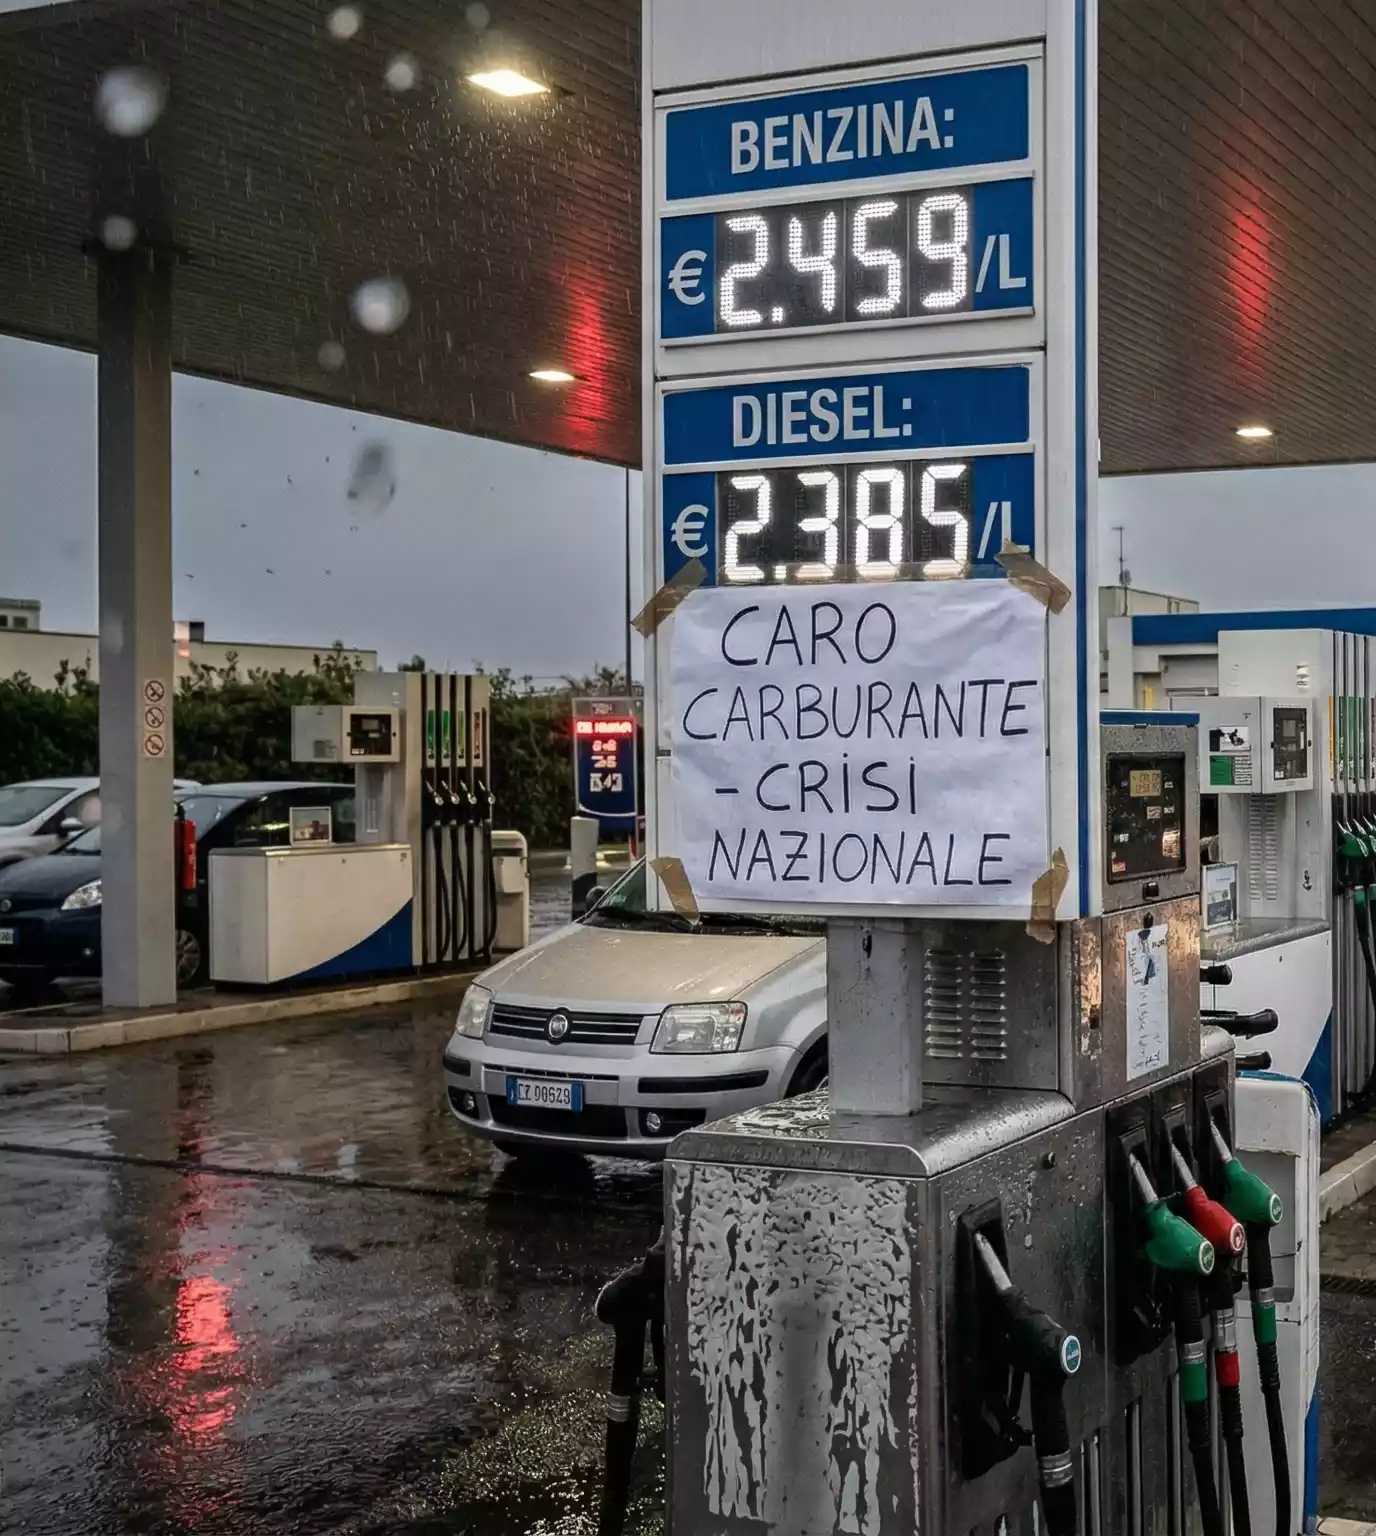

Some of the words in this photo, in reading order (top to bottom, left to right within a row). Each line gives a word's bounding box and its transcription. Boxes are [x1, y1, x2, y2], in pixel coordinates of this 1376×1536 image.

[731, 97, 954, 174] BENZINA:
[668, 250, 707, 305] €
[719, 193, 969, 327] 2.459
[975, 234, 1027, 293] /L
[732, 386, 912, 448] DIESEL:
[670, 504, 709, 557] €
[724, 464, 970, 580] 2.385
[721, 602, 897, 666] CARO
[683, 679, 1038, 742] CARBURANTE
[708, 828, 1013, 886] NAZIONALE
